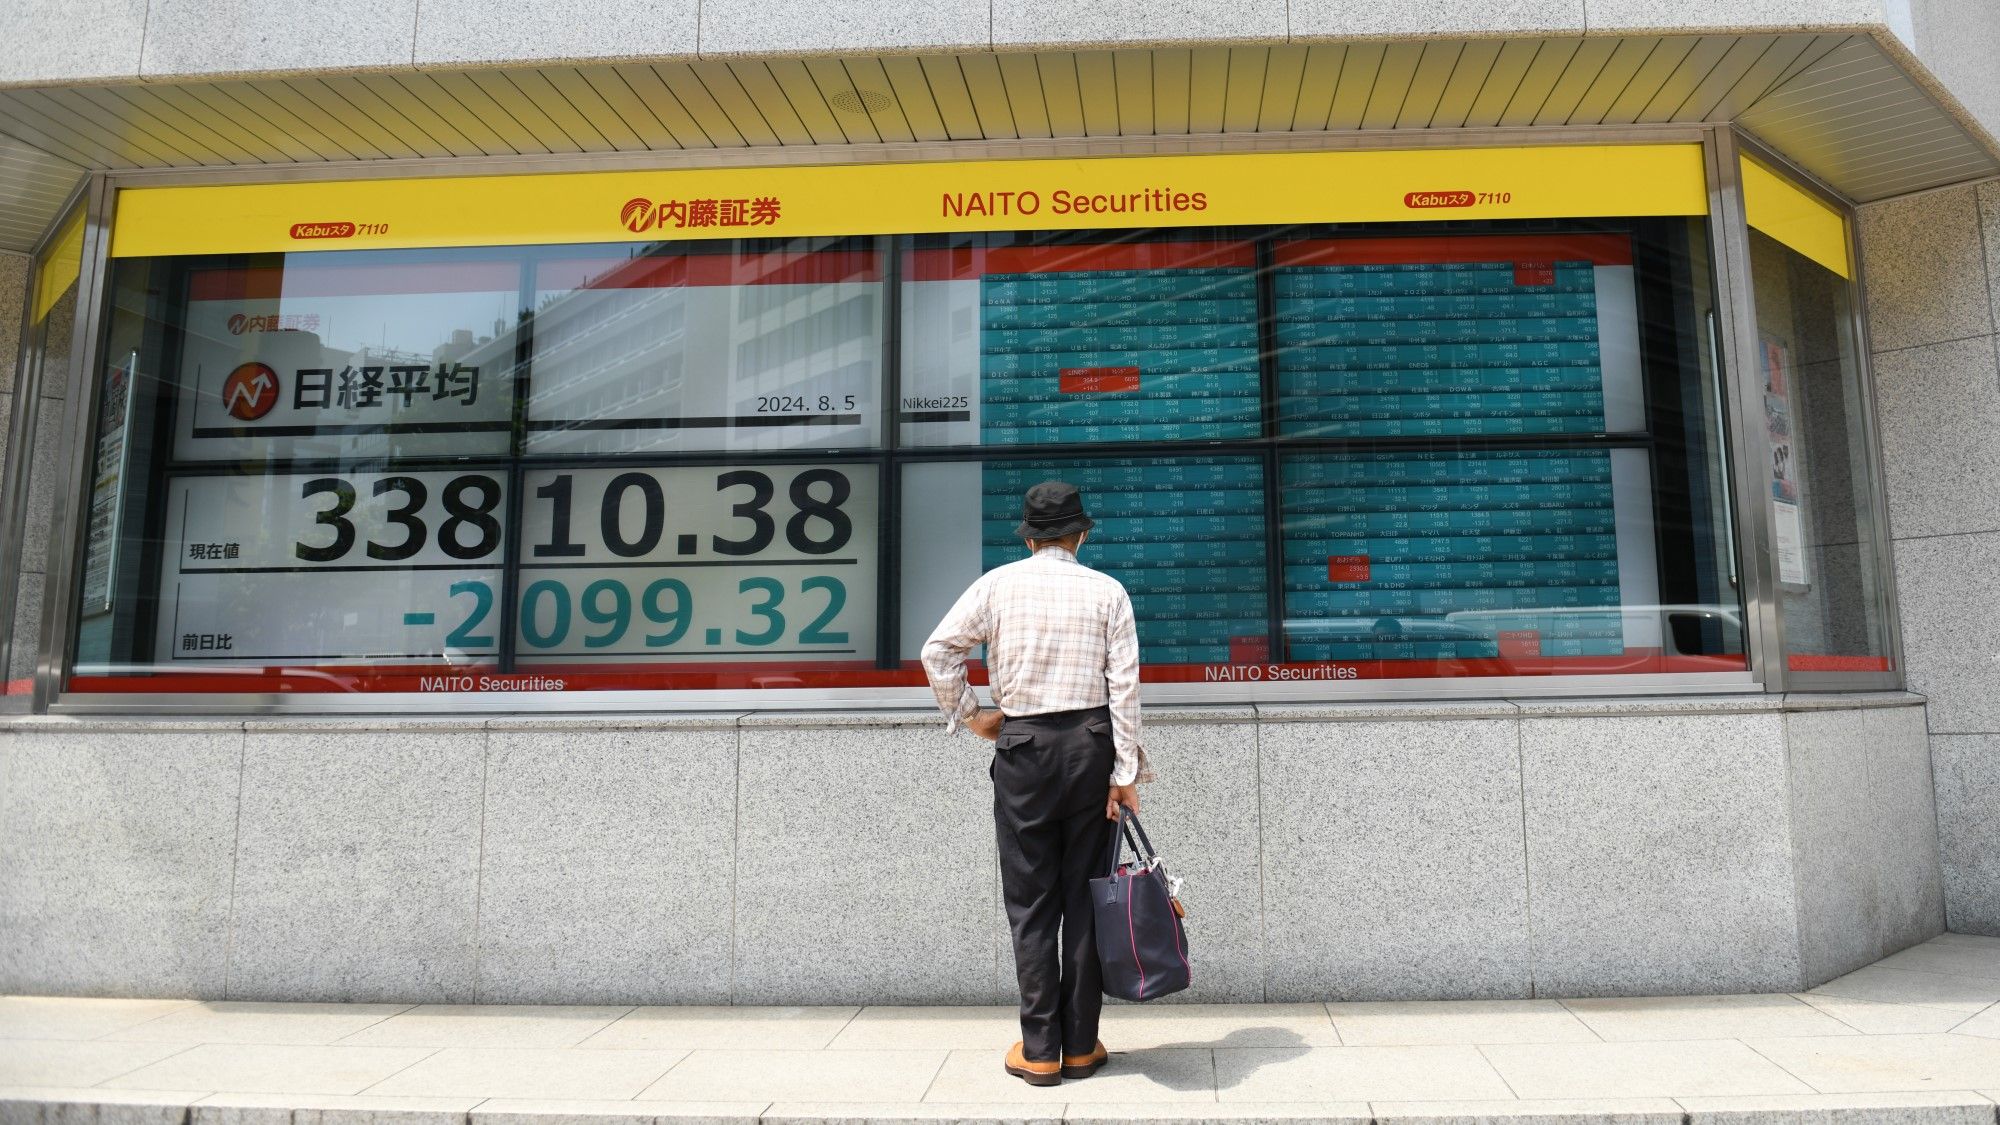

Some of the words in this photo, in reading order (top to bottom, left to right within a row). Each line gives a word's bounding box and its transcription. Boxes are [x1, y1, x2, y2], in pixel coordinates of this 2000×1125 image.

[942, 191, 1040, 217] NAITO
[1051, 188, 1208, 215] Securities
[1411, 193, 1469, 206] Kabuスタ
[1478, 193, 1511, 204] 7110
[658, 197, 781, 228] 内藤証券
[295, 225, 350, 237] Kabuスタ
[357, 223, 388, 235] 7110
[249, 313, 320, 332] 内藤証券
[293, 362, 479, 409] 日経平均
[903, 397, 967, 409] Nikkei225
[189, 543, 240, 560] 現在値
[182, 634, 232, 650] 前日比
[1205, 666, 1261, 681] NAITO
[1268, 664, 1357, 681] Securities
[420, 677, 473, 691] NAITO
[479, 676, 564, 691] Securities
